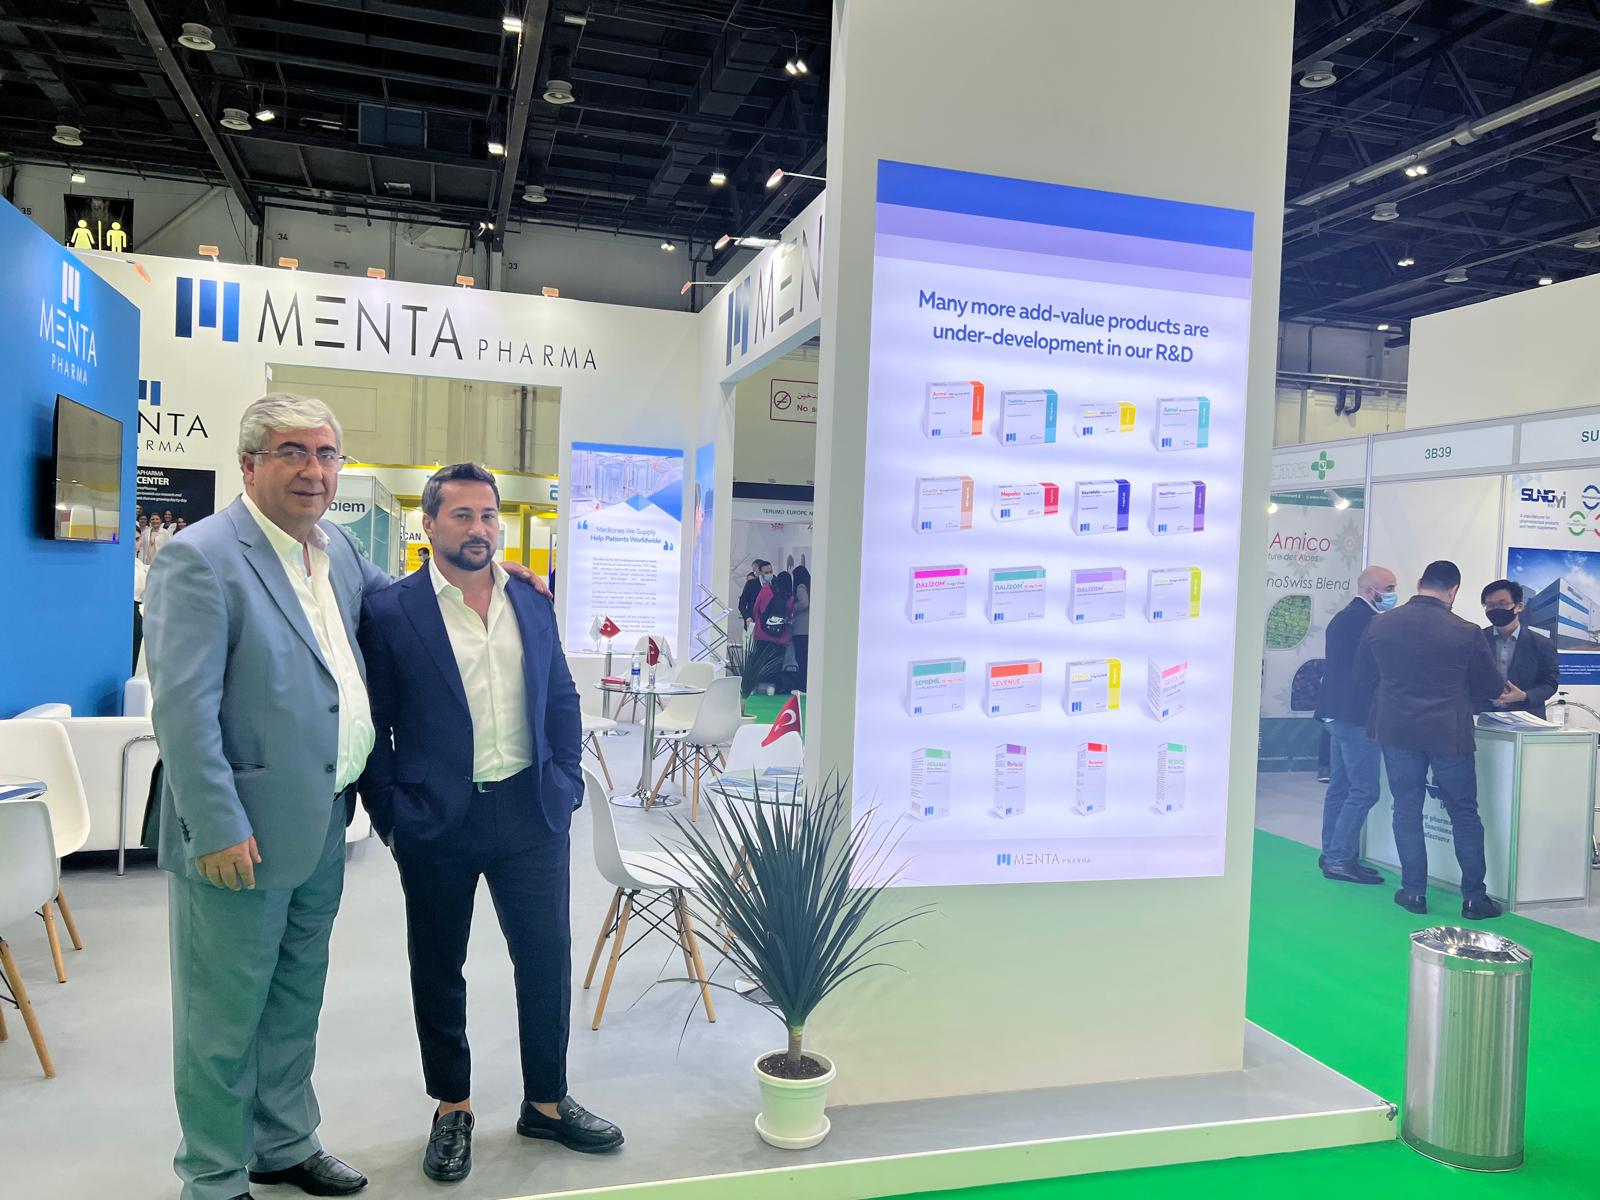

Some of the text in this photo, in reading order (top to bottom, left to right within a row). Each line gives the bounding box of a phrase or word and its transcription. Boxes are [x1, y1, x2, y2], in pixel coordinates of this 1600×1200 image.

[277, 232, 289, 241] 34
[507, 262, 519, 270] 33
[919, 289, 968, 318] Many
[971, 300, 1016, 318] more
[1019, 303, 1105, 327] add-value
[1183, 323, 1209, 338] are
[39, 298, 97, 367] MENTA
[257, 287, 597, 371] MENTA PHARMA
[933, 324, 1194, 363] under-development in our R&D
[51, 353, 88, 386] PHARMA
[796, 404, 809, 412] No
[137, 440, 185, 453] RMA
[1424, 447, 1452, 460] 3B39
[136, 477, 170, 486] CENTER
[596, 527, 625, 535] Medicines
[636, 528, 657, 537] Supply
[590, 534, 662, 544] Help Patients Worldwide
[1269, 531, 1331, 552] Amico
[1316, 577, 1351, 591] Blend
[1013, 853, 1060, 866] MENTA
